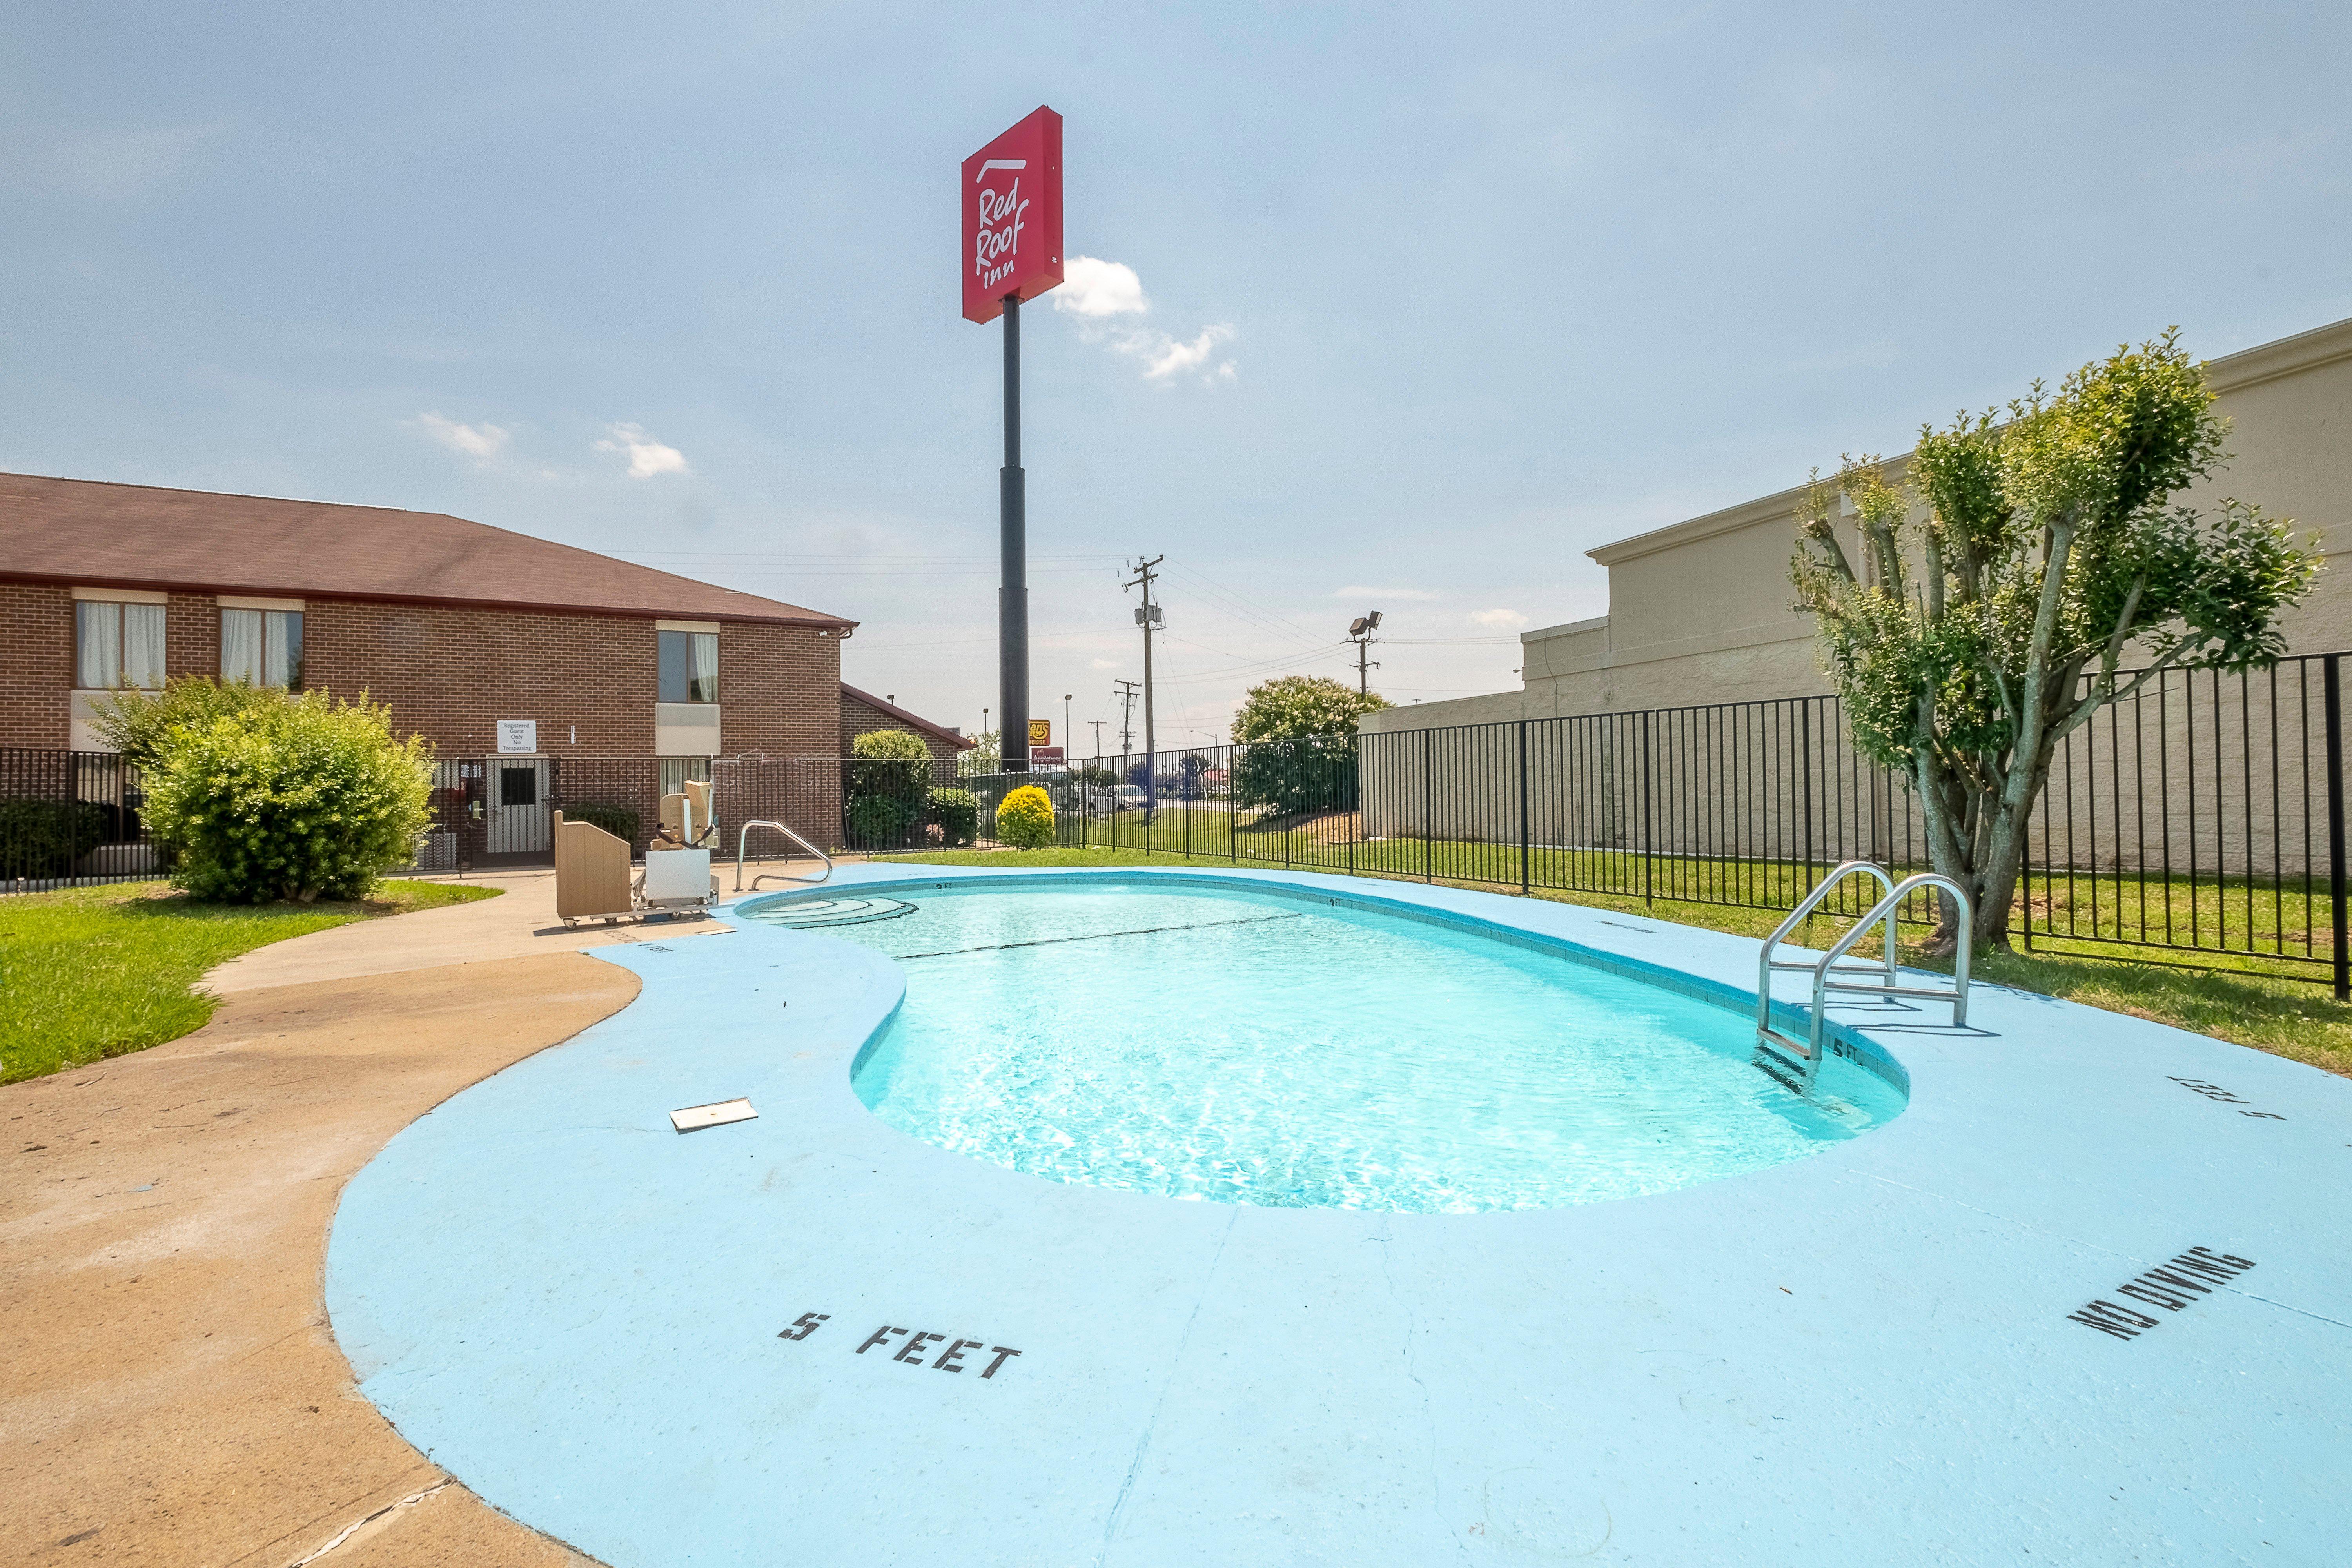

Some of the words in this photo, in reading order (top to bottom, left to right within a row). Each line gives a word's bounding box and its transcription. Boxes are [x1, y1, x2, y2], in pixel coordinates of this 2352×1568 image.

[979, 176, 1019, 229] Red
[975, 198, 1029, 276] Roof
[1335, 898, 1341, 906] FT
[1832, 1038, 1843, 1057] 5
[1847, 1044, 1858, 1062] FT
[2165, 1076, 2252, 1104] FEET
[2236, 1110, 2287, 1121] 5
[2066, 1300, 2160, 1341] NO
[2117, 1245, 2256, 1312] DIVING
[777, 1312, 831, 1340] 5
[855, 1326, 1022, 1379] FEET
